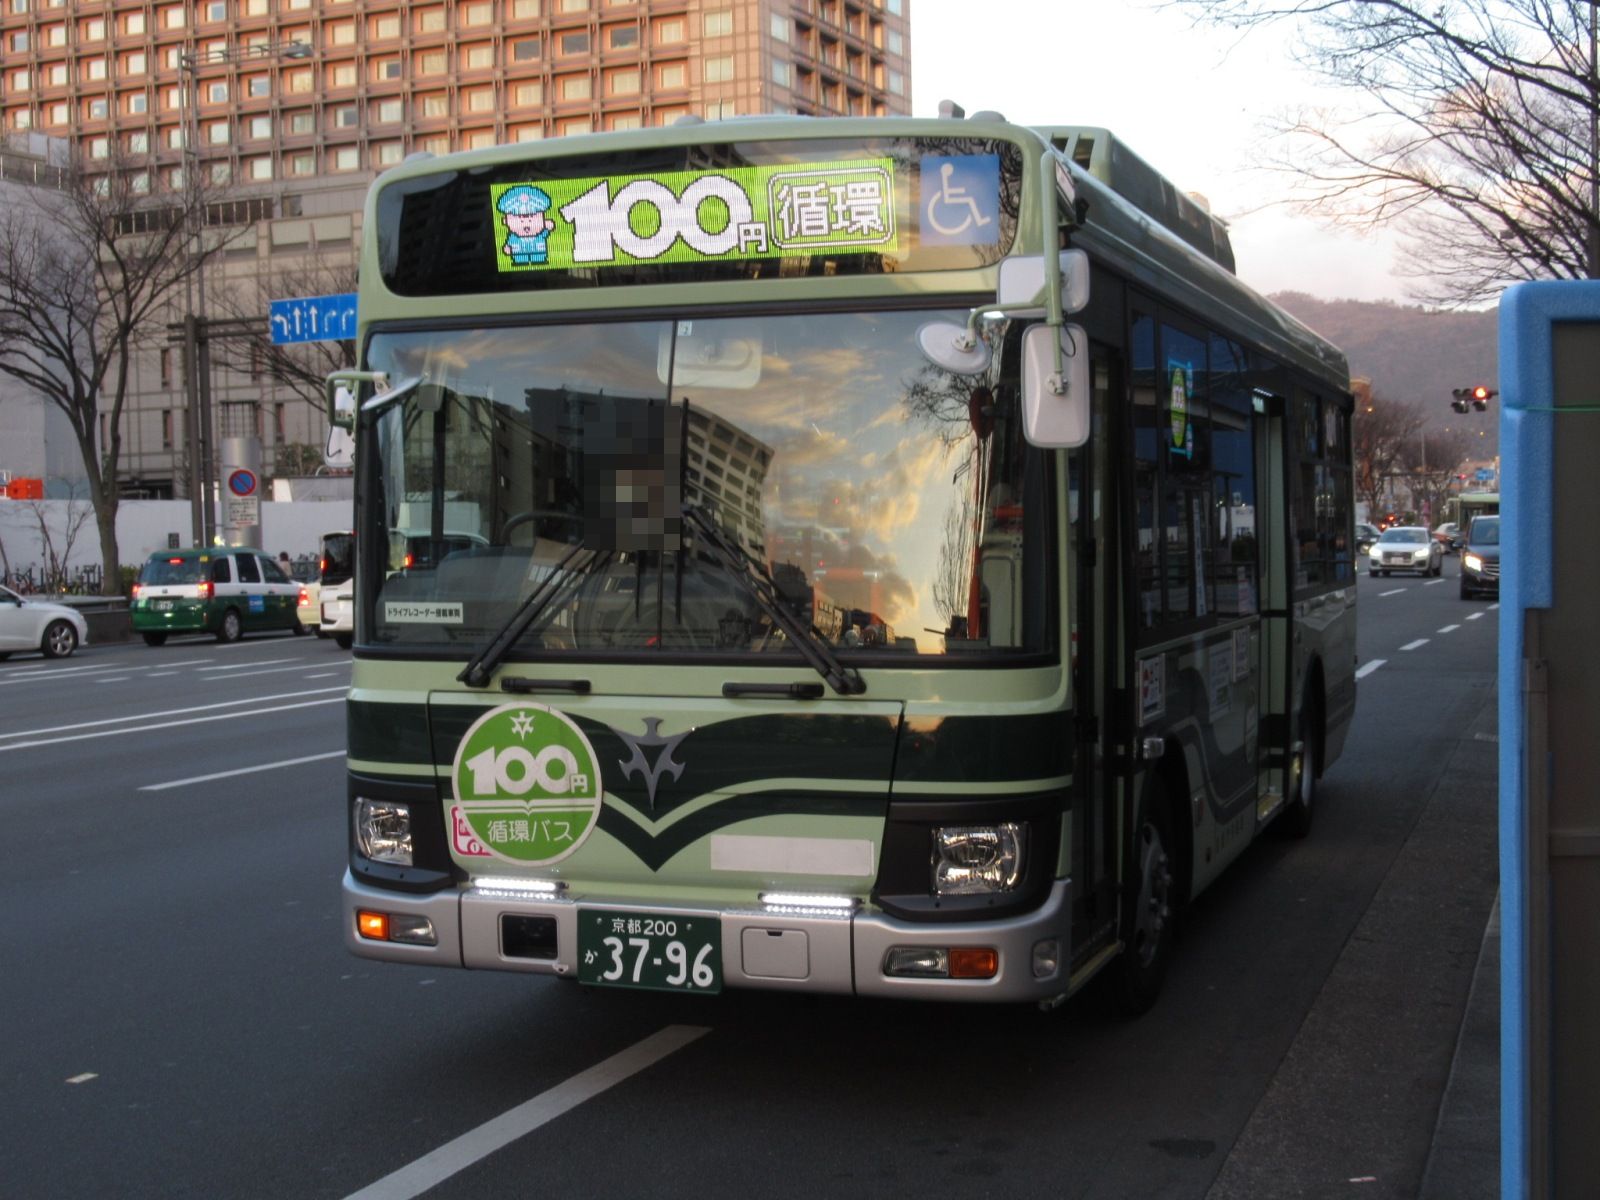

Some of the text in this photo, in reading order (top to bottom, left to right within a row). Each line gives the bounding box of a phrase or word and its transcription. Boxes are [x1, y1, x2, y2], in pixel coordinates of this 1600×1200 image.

[559, 174, 769, 263] 100円
[777, 180, 884, 240] 循環
[465, 744, 589, 795] 100円
[487, 820, 574, 843] 循環バス
[602, 936, 714, 987] 37-96
